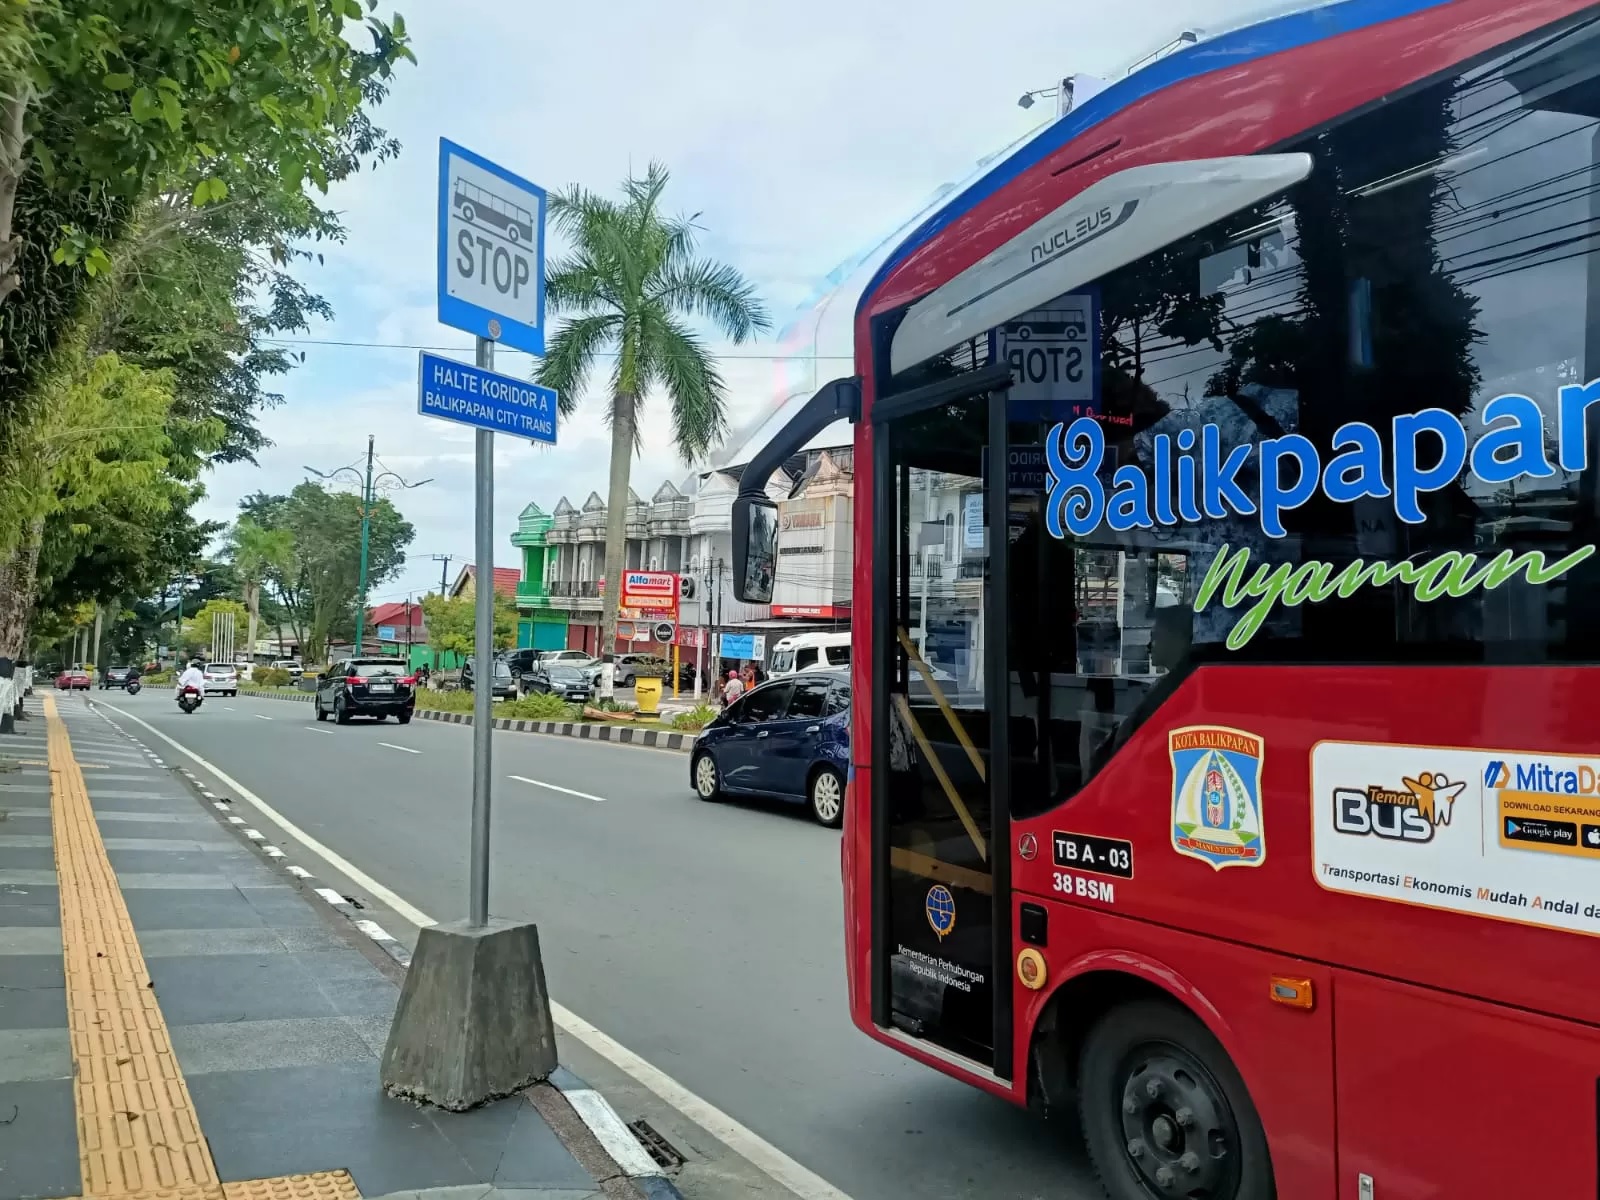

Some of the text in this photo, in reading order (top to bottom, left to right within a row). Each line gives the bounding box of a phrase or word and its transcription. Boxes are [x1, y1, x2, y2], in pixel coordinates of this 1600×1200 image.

[1031, 206, 1111, 263] NUCLEUS
[456, 229, 529, 299] STOP
[434, 364, 548, 412] HALTE KORIDOR A
[425, 391, 552, 435] BALIKPAPAN CITY TRANS
[629, 575, 671, 585] Alfamart
[1194, 543, 1596, 650] Nyaman
[1175, 733, 1256, 756] KOTA BALIKPAPAN
[1516, 762, 1600, 795] MitraD
[1368, 787, 1416, 806] Teman
[1503, 801, 1600, 817] DOWNLOAD SEKARANG
[1522, 825, 1573, 840] Google play
[1055, 839, 1078, 860] TB
[1081, 844, 1095, 864] A
[1109, 849, 1129, 870] 03
[1052, 872, 1115, 903] 38 BSM
[1322, 863, 1400, 886] Transportasi
[1403, 875, 1472, 899] Ekonomis
[1476, 887, 1528, 907] Mudah
[1531, 895, 1579, 916] Andal
[898, 944, 984, 983] Kementerian Perhubungan
[909, 960, 937, 980] Republik
